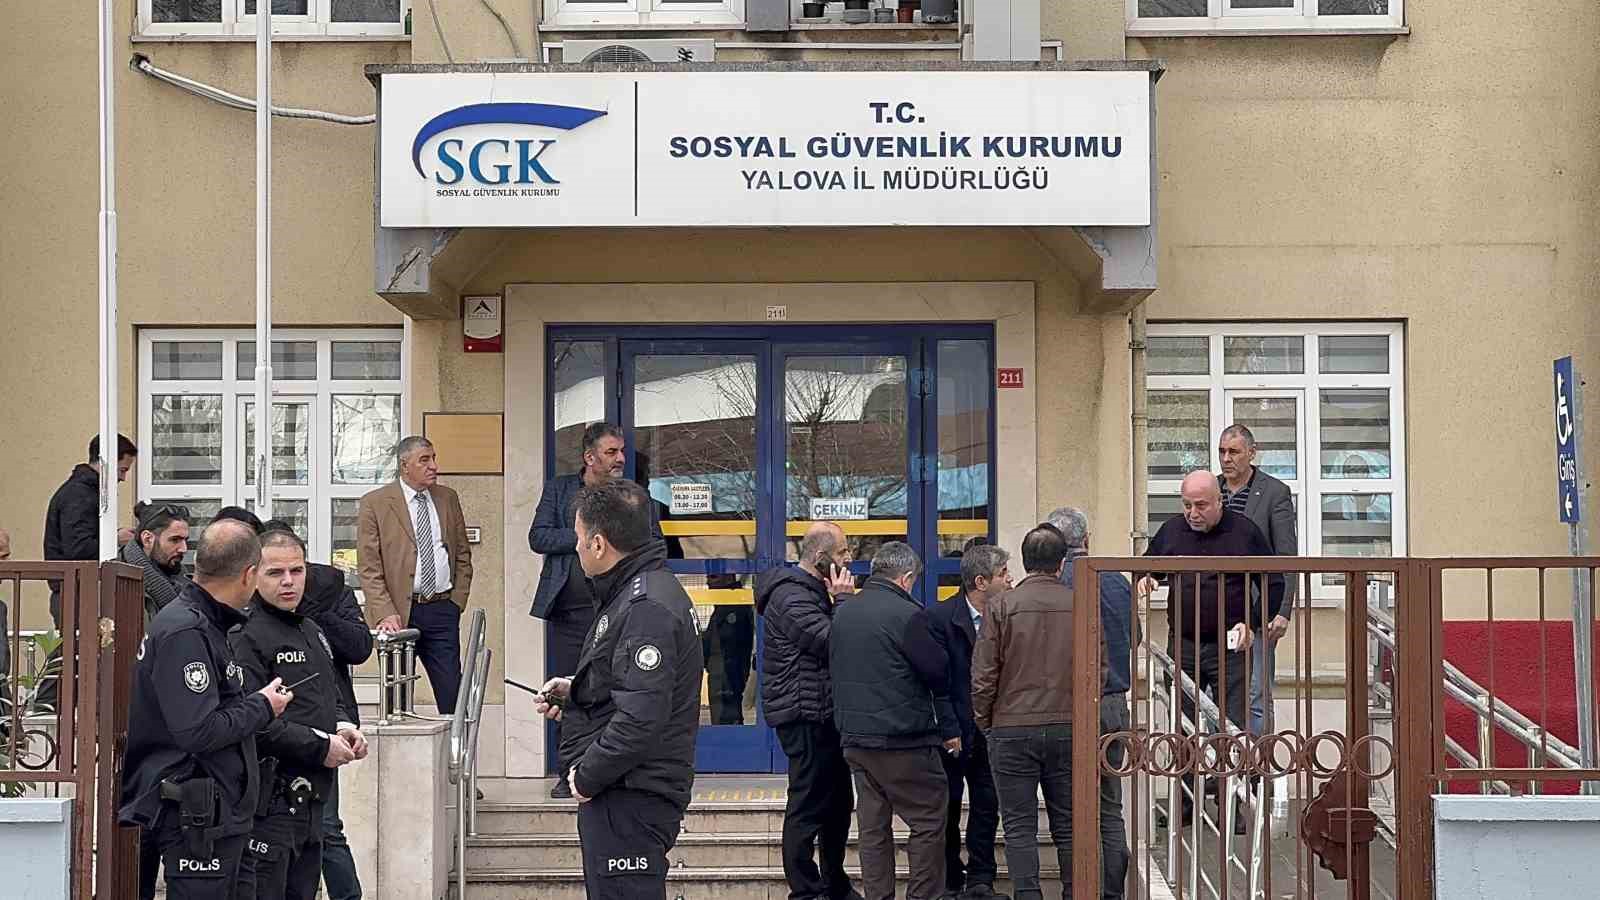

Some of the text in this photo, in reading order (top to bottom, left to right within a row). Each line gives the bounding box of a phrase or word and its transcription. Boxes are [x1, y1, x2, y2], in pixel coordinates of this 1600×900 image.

[869, 102, 925, 124] T.C.
[669, 131, 1122, 158] SOSYAL GÜVENLİK KURUMU
[435, 138, 561, 187] SGK
[741, 165, 1048, 190] YALOVA İL MÜDÜRLÜĞÜ
[436, 187, 560, 198] SOSYAL GÜVENLİK KURUMU
[1000, 373, 1022, 384] 211
[814, 501, 866, 518] ÇEKİNİZ
[248, 839, 269, 854] LİS
[608, 857, 649, 872] POLİS
